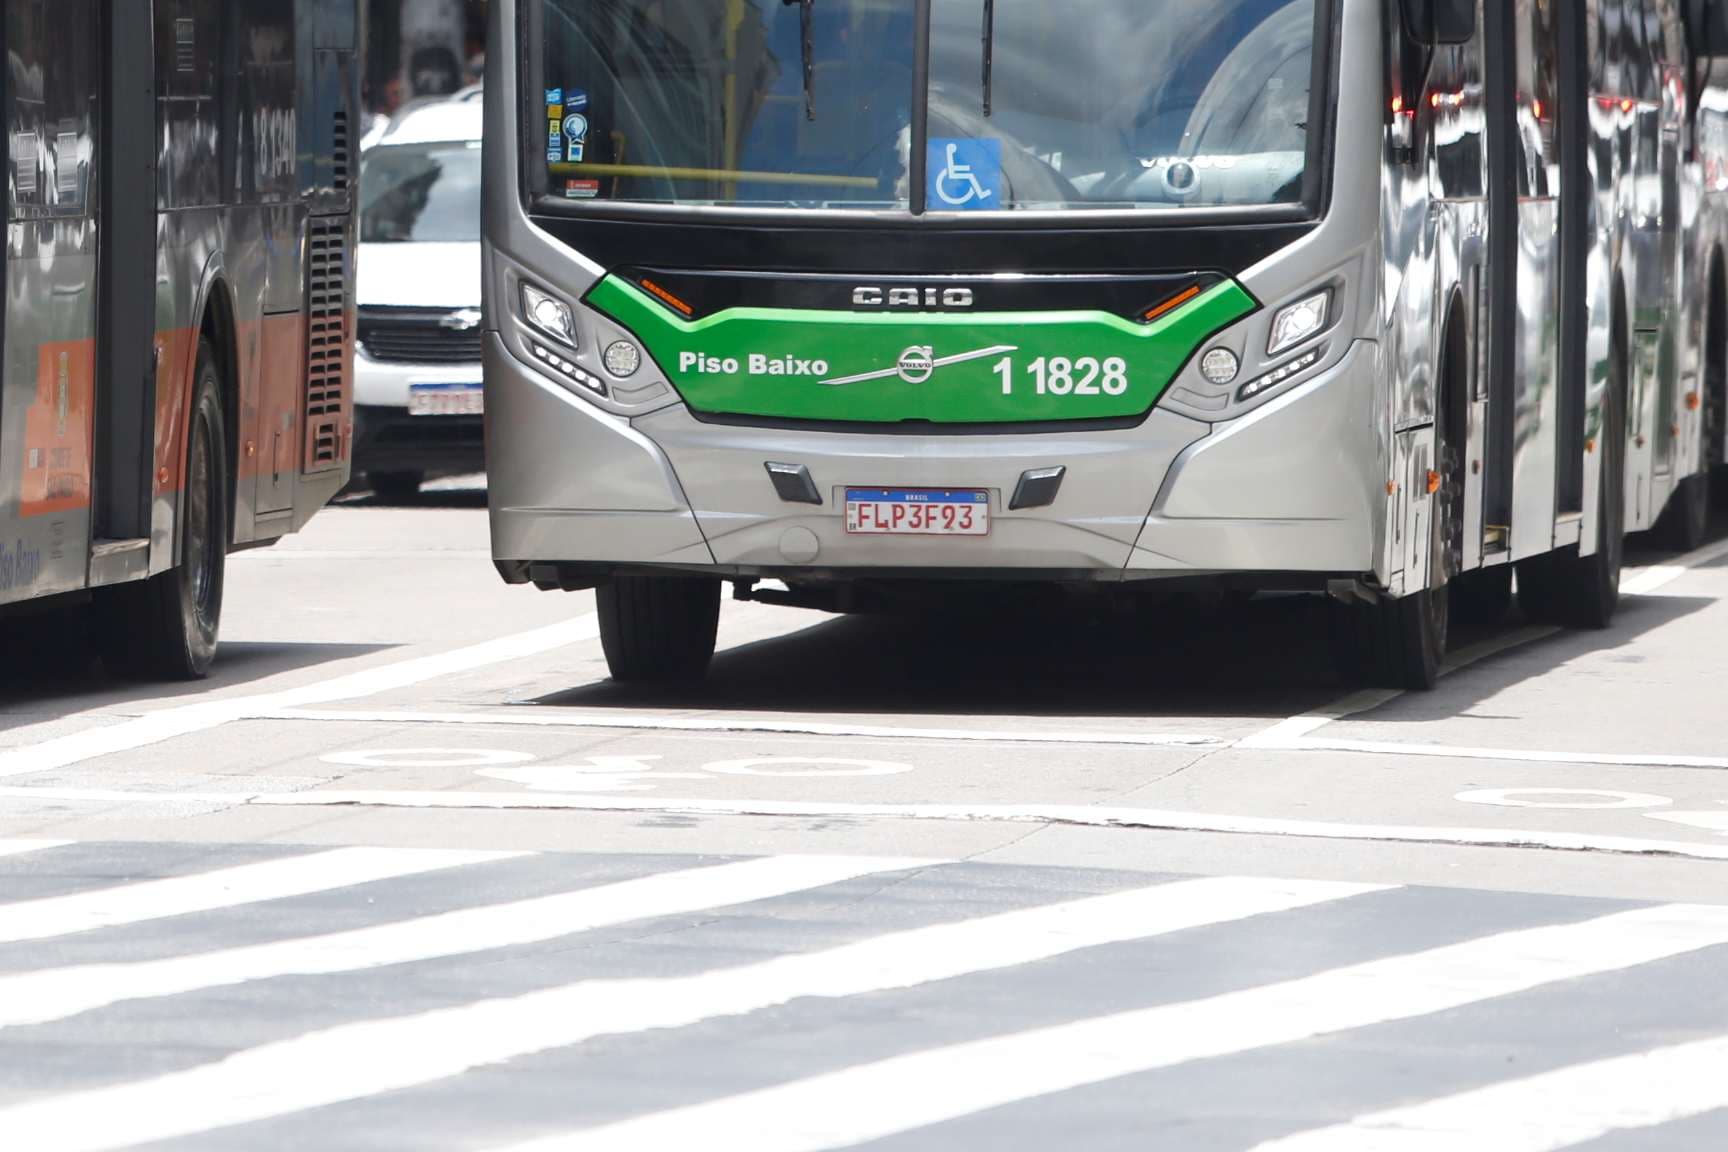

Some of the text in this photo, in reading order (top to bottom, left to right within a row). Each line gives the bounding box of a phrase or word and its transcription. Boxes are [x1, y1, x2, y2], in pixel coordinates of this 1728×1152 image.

[851, 286, 973, 306] CAIO
[679, 351, 829, 377] Piso Baixo
[898, 361, 932, 369] VOLVO
[1026, 356, 1129, 396] 1828
[857, 503, 973, 529] FLP3F93
